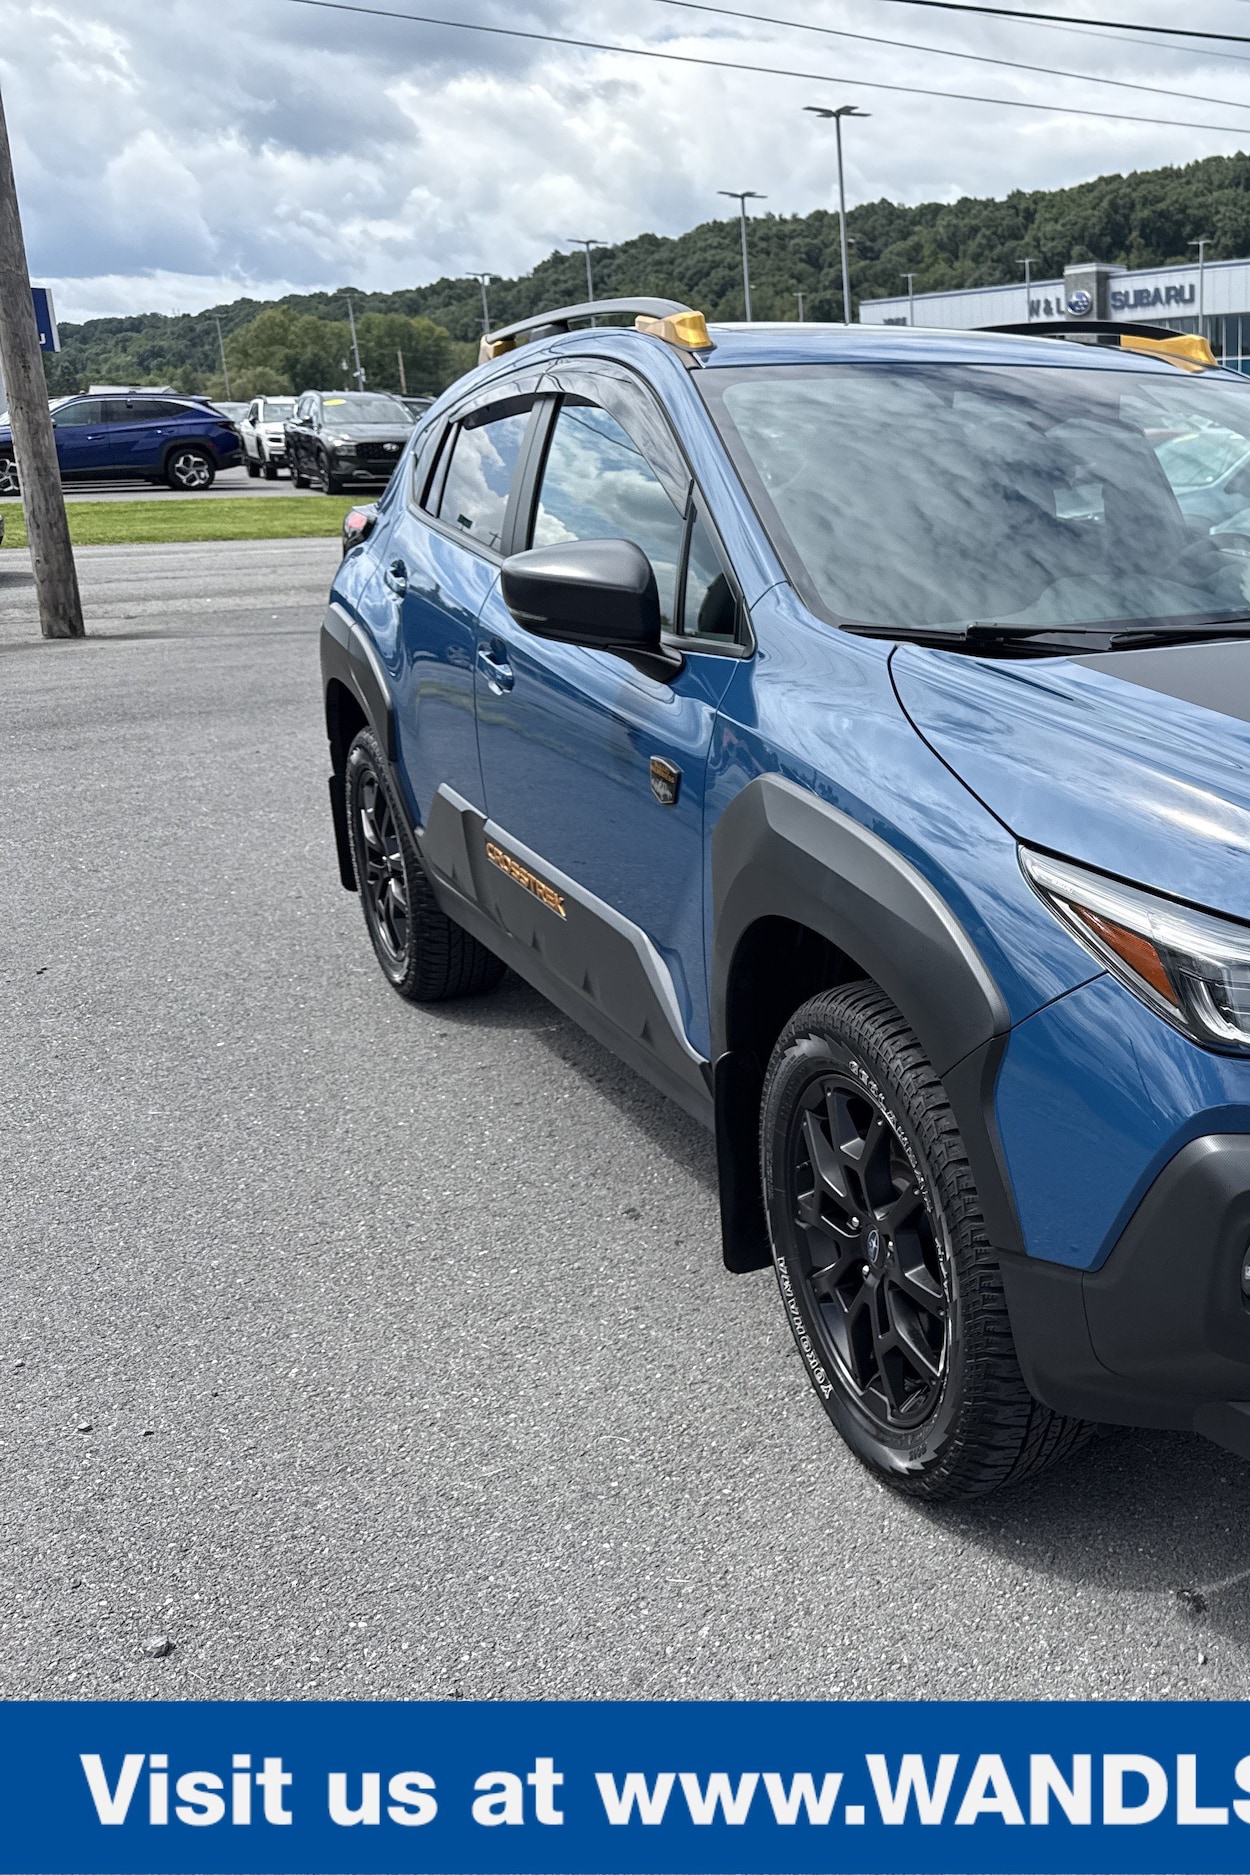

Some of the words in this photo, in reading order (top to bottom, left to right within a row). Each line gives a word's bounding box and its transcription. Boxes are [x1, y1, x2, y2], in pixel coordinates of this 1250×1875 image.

[1056, 297, 1065, 315] L
[1111, 283, 1196, 311] SUBARU
[486, 842, 567, 917] CROSSTREK
[776, 1256, 834, 1400] YOKOHAMA
